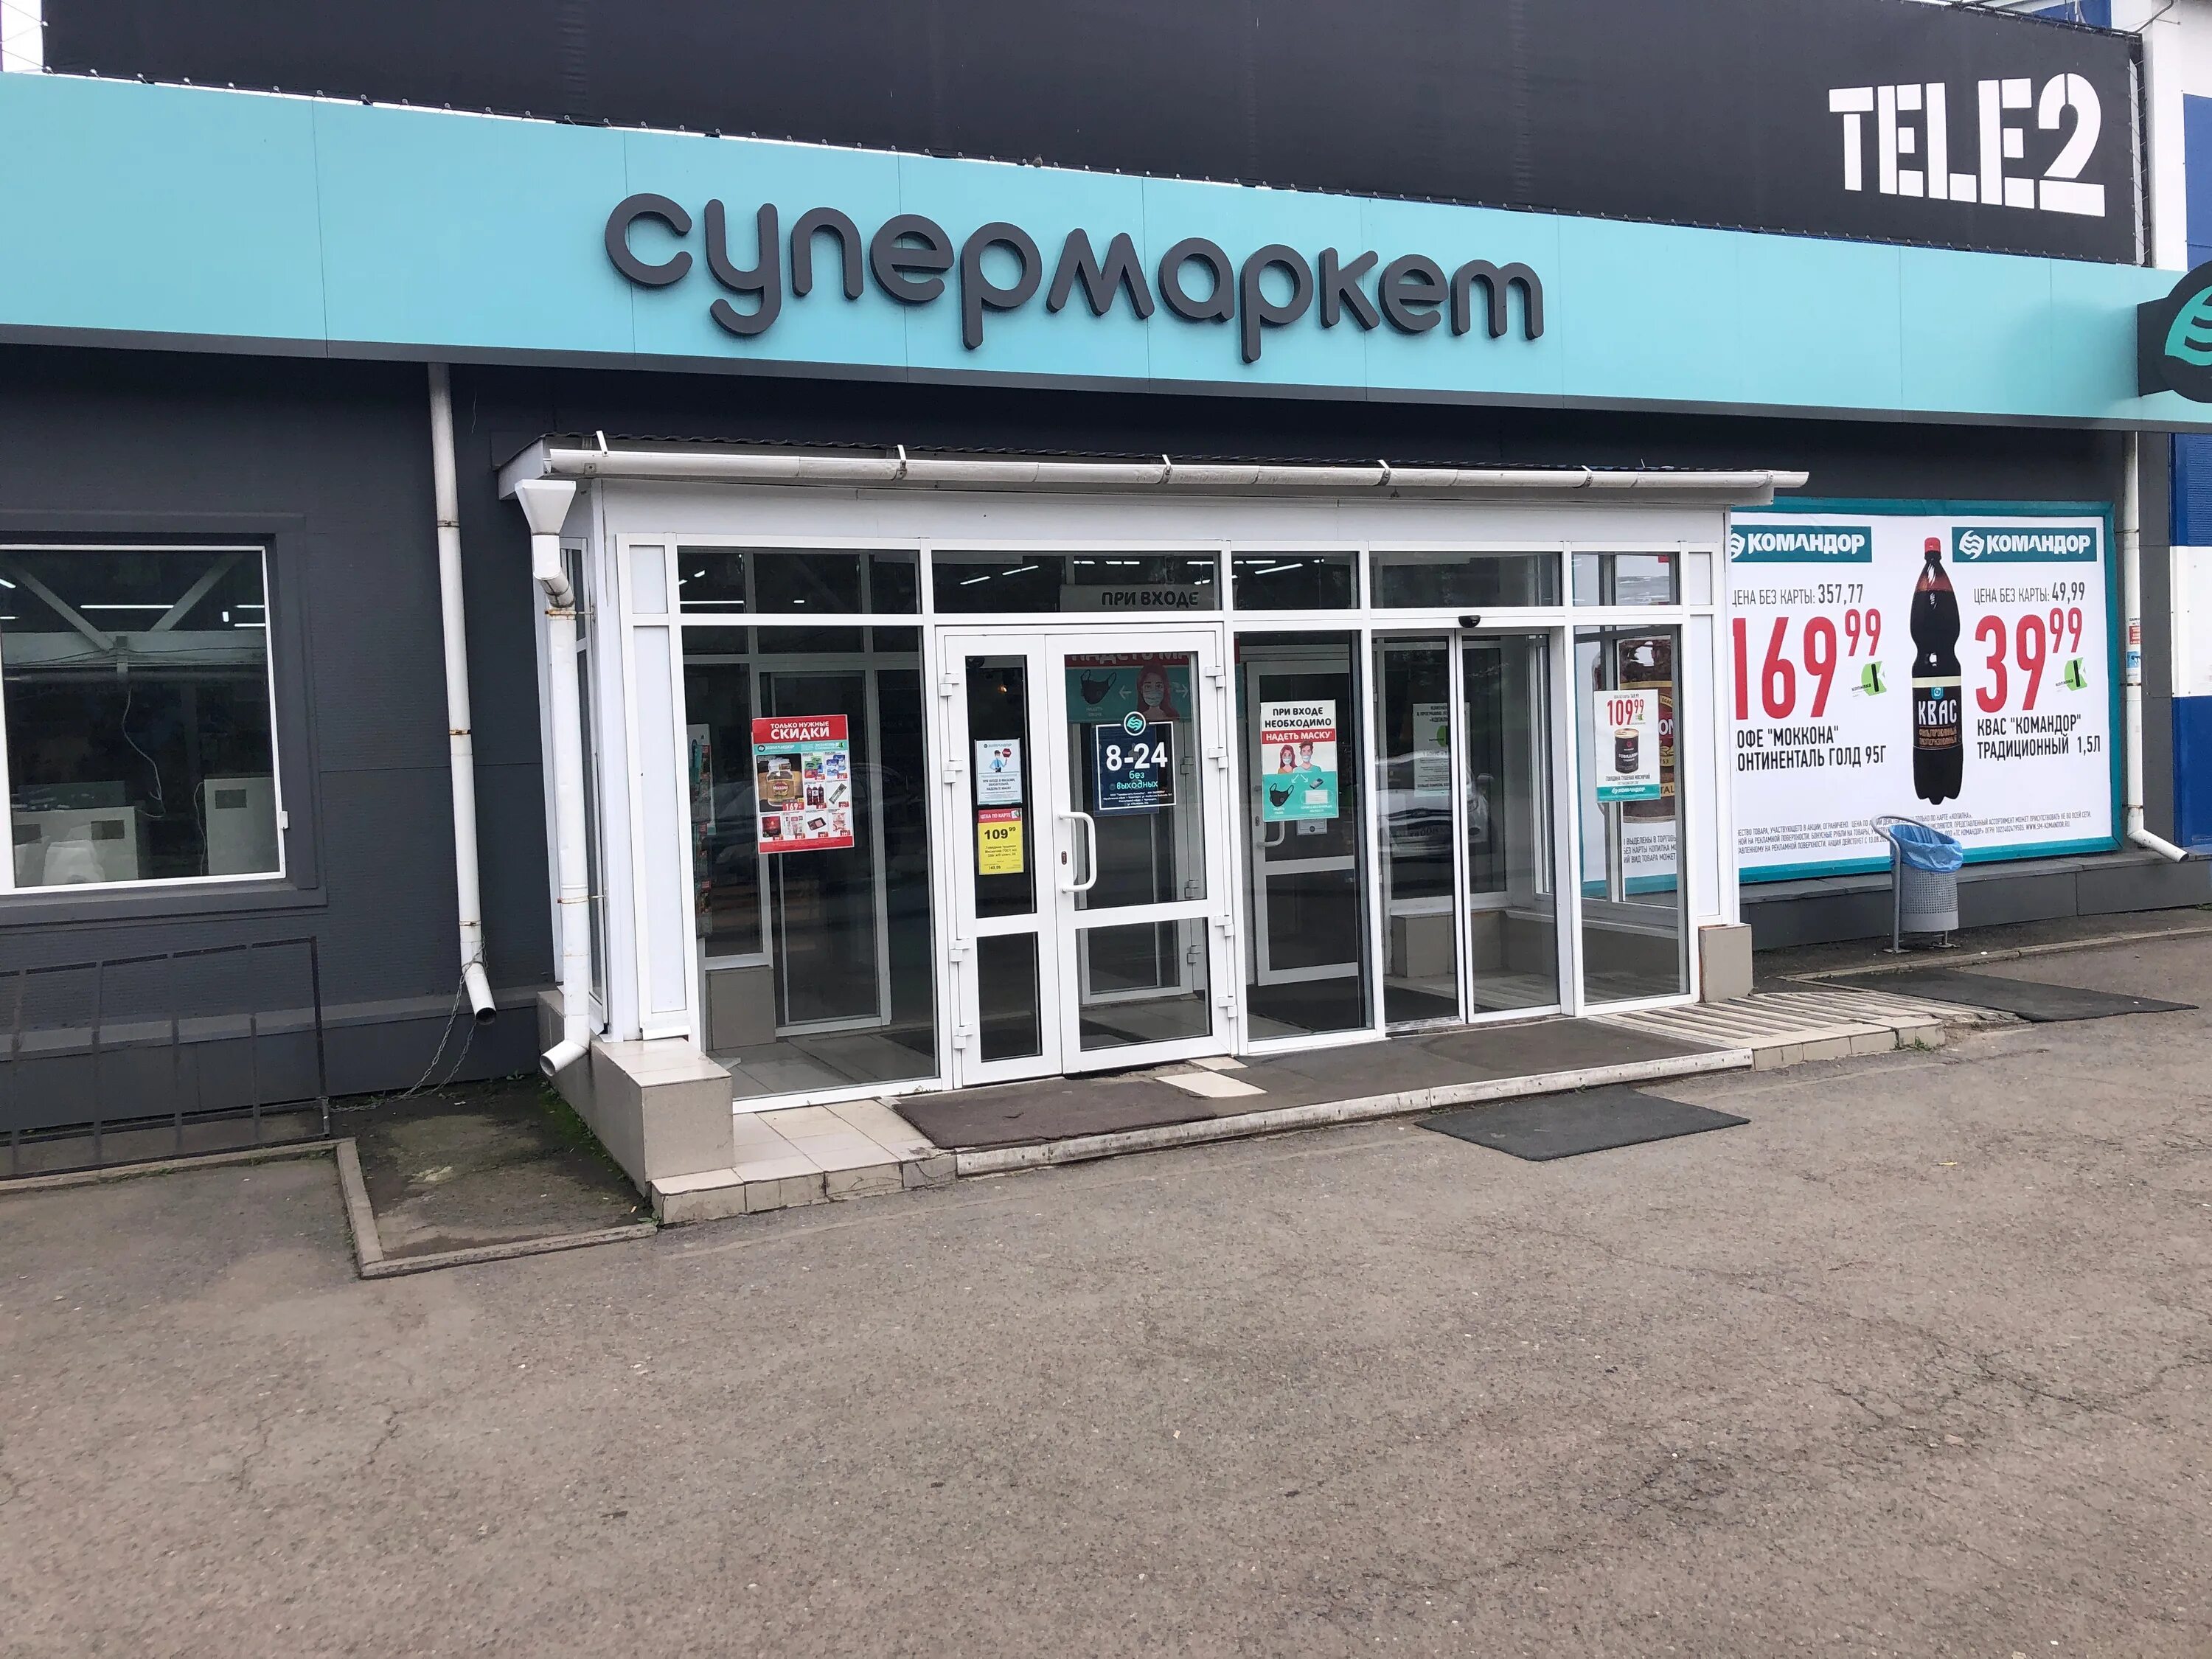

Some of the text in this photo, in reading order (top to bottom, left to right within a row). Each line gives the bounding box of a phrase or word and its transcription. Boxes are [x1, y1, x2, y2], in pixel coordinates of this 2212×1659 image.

[1829, 73, 2105, 217] TELE2
[605, 192, 1544, 363] супермаркет
[1747, 533, 1865, 554] КОМАНДОР
[1986, 535, 2091, 554] КОМАНДОР
[1102, 591, 1199, 608] ПРИ ВХОДЕ
[1759, 589, 1777, 605] БЕЗ
[1780, 589, 1815, 605] КАРТЫ:
[1818, 583, 1864, 605] 357,77
[1974, 582, 2085, 605] ЦЕНА БЕЗ КАРТЫ: 49,99
[1976, 607, 2082, 713] 39 99
[1273, 707, 1324, 716] ПРИ ВХОДЕ
[1607, 699, 1644, 726] 109 99
[1918, 699, 1957, 726] КВАС
[771, 726, 830, 740] СКИДКИ
[1265, 718, 1332, 728] НЕОБХОДИМО
[1978, 714, 2081, 736] КВАС "КОМАНДОР"
[1266, 732, 1299, 742] НАДЕТЬ
[1736, 726, 1838, 748] ОФЕ "МОККОНА"
[1106, 742, 1168, 771] 8-24
[1978, 734, 2101, 761] ТРАДИЦИОННЫЙ 1,5Л
[1736, 745, 1887, 771] ОНТИНЕНТАЛЬ ГОЛД 95Г
[1116, 780, 1158, 790] выходных
[1129, 771, 1144, 779] без
[984, 829, 1008, 840] 109
[1627, 836, 1652, 845] ВЫДЕЛЕНЫ
[1631, 855, 1641, 863] ВИД
[1642, 854, 1658, 862] ТОВАРА
[1659, 852, 1676, 860] МОЖЕТ
[1632, 846, 1648, 854] КАРТЫ
[1649, 844, 1669, 852] КОПИЛКА
[1738, 846, 1764, 855] АВЛЕННОМУ
